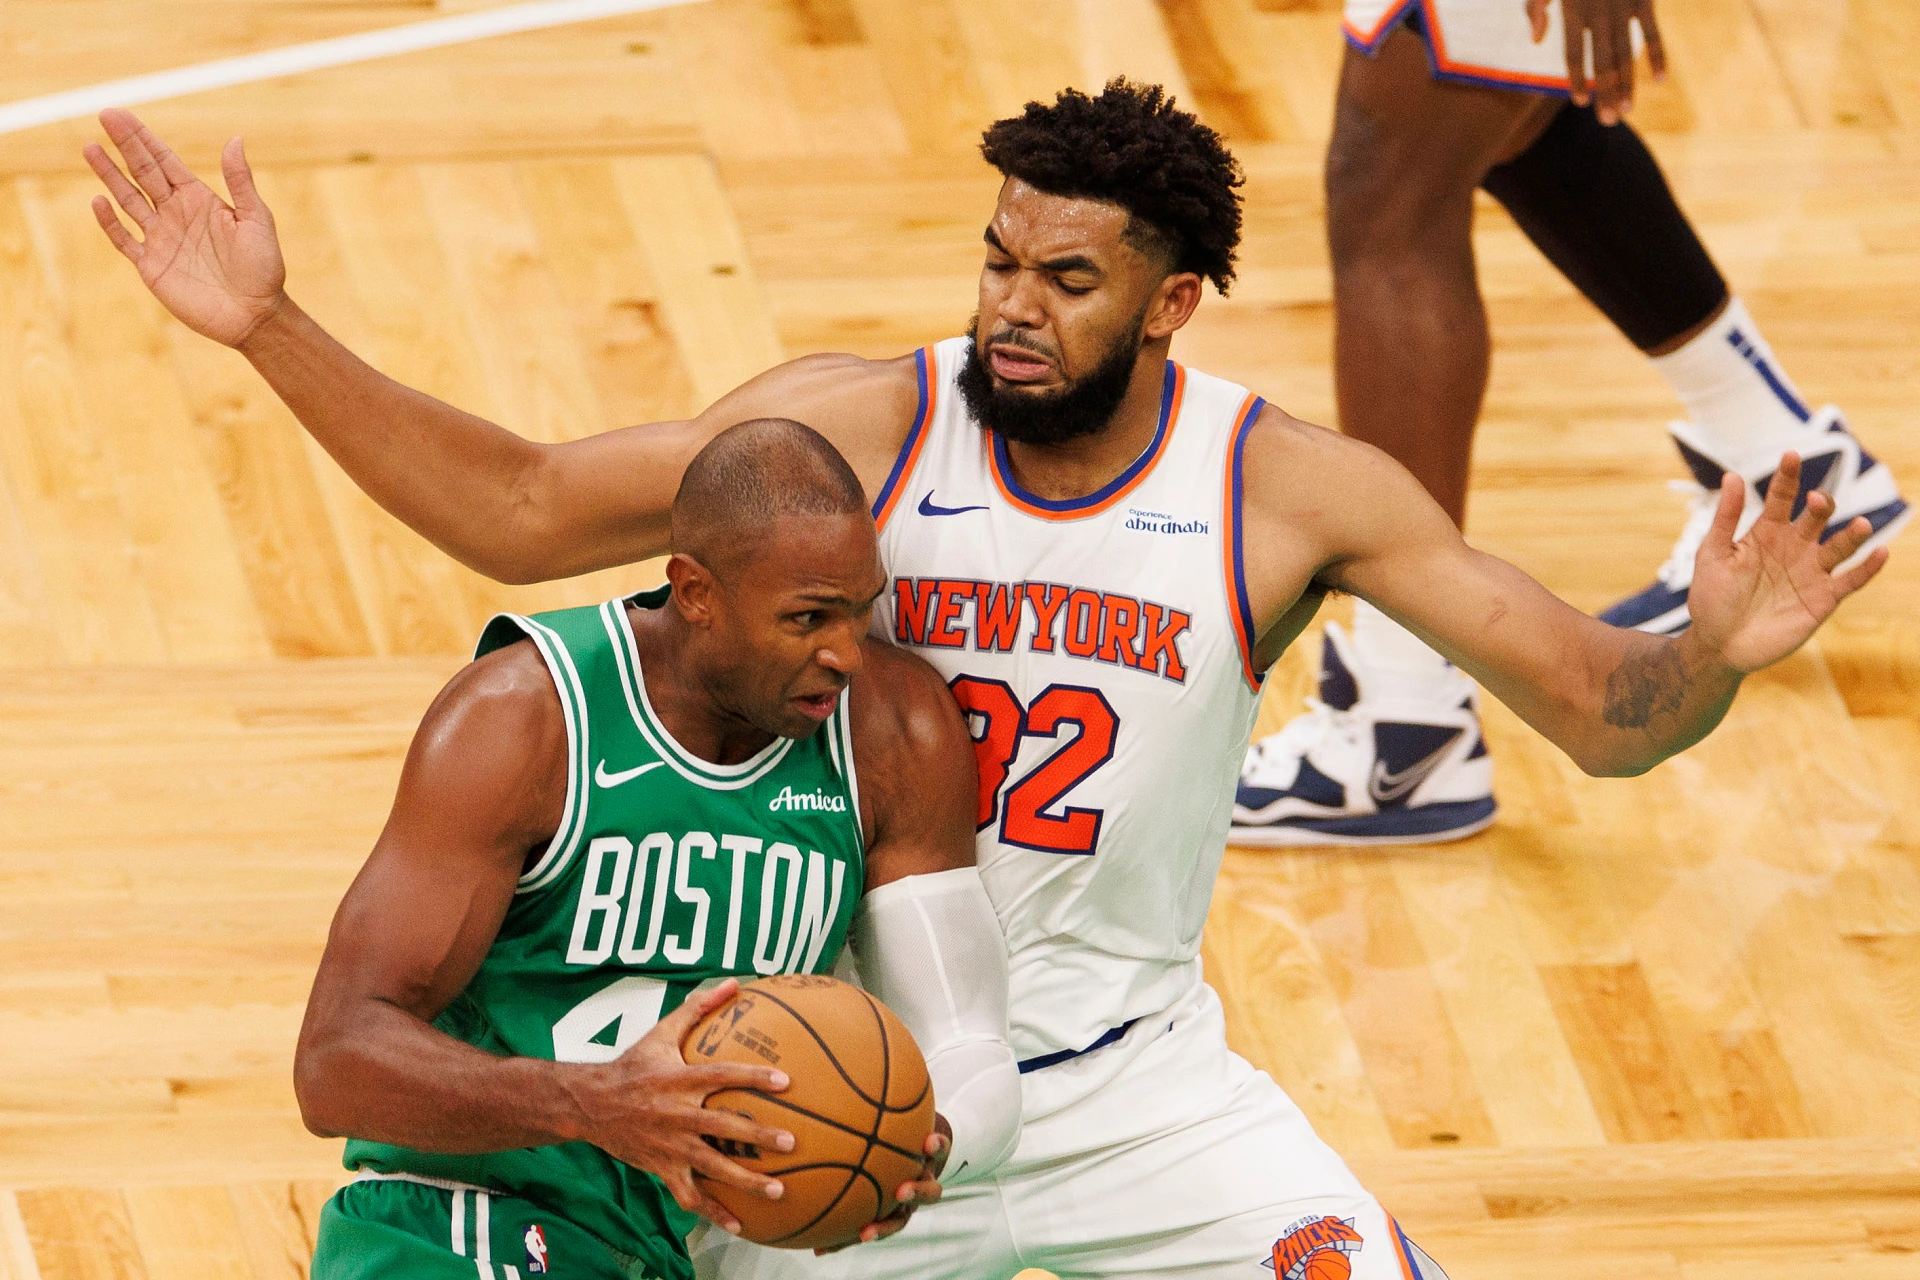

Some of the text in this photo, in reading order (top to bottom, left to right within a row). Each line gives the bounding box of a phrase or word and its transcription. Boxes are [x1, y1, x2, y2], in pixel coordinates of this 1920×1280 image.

[1125, 518, 1209, 534] abu dhabi
[1129, 508, 1172, 520] experience
[769, 786, 846, 812] Amica
[565, 831, 847, 976] BOSTON
[1272, 1216, 1364, 1280] KNICKS
